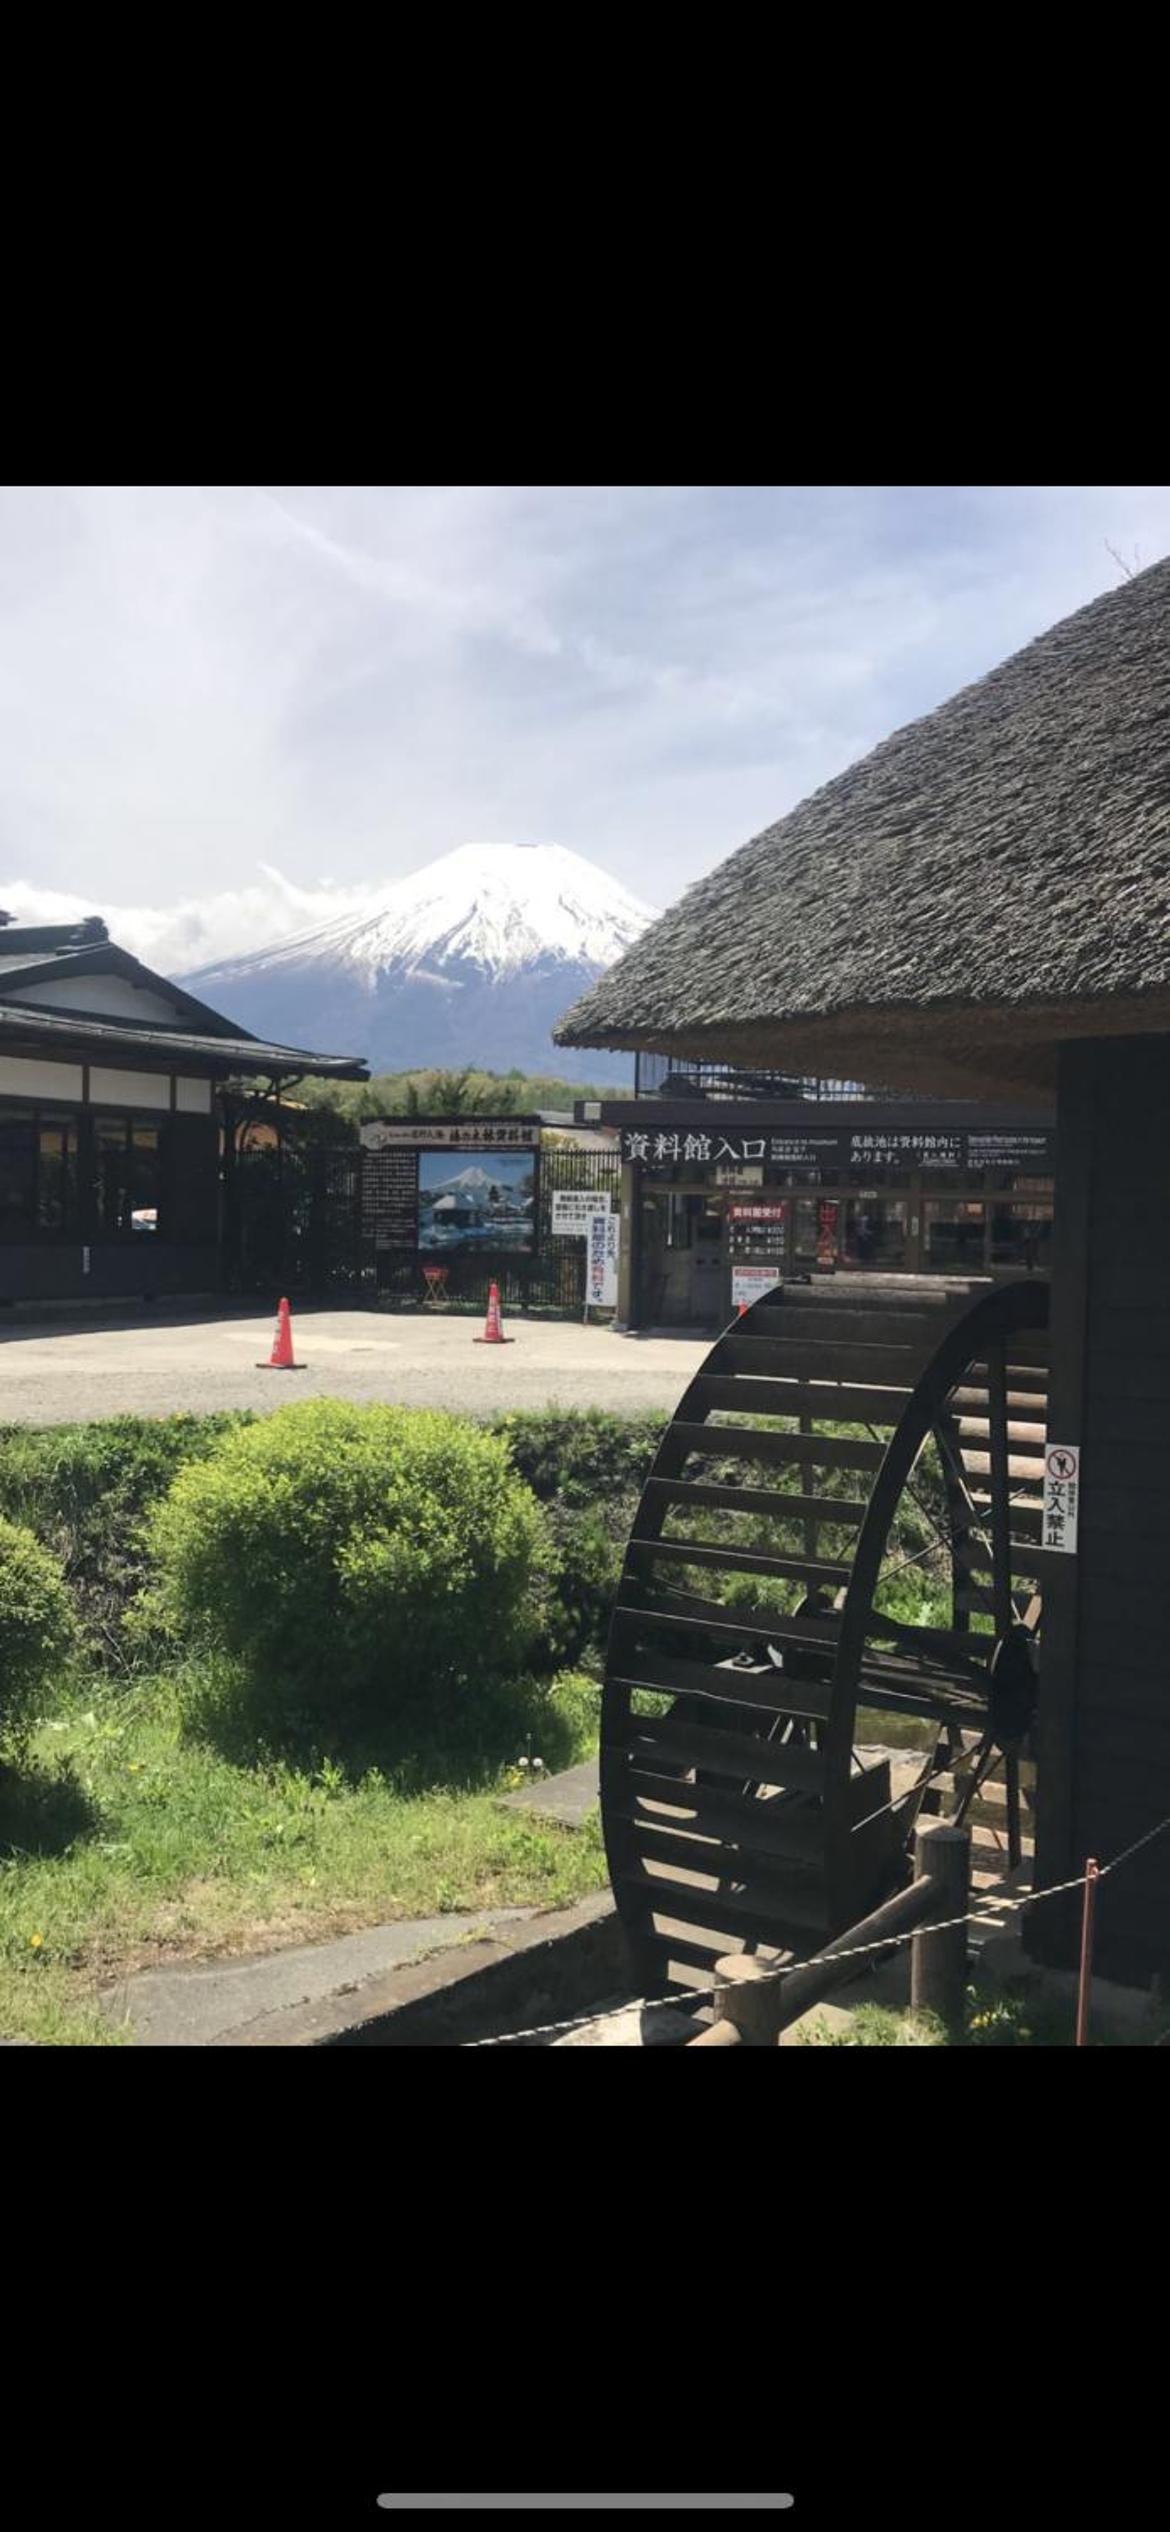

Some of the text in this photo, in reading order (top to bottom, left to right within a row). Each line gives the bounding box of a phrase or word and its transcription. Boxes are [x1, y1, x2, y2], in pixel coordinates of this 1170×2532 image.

[625, 1132, 767, 1162] 資料館入口
[850, 1135, 961, 1149] 底抜池は資料館内に
[850, 1150, 900, 1165] あります。
[1045, 1481, 1066, 1548] 立入禁止
